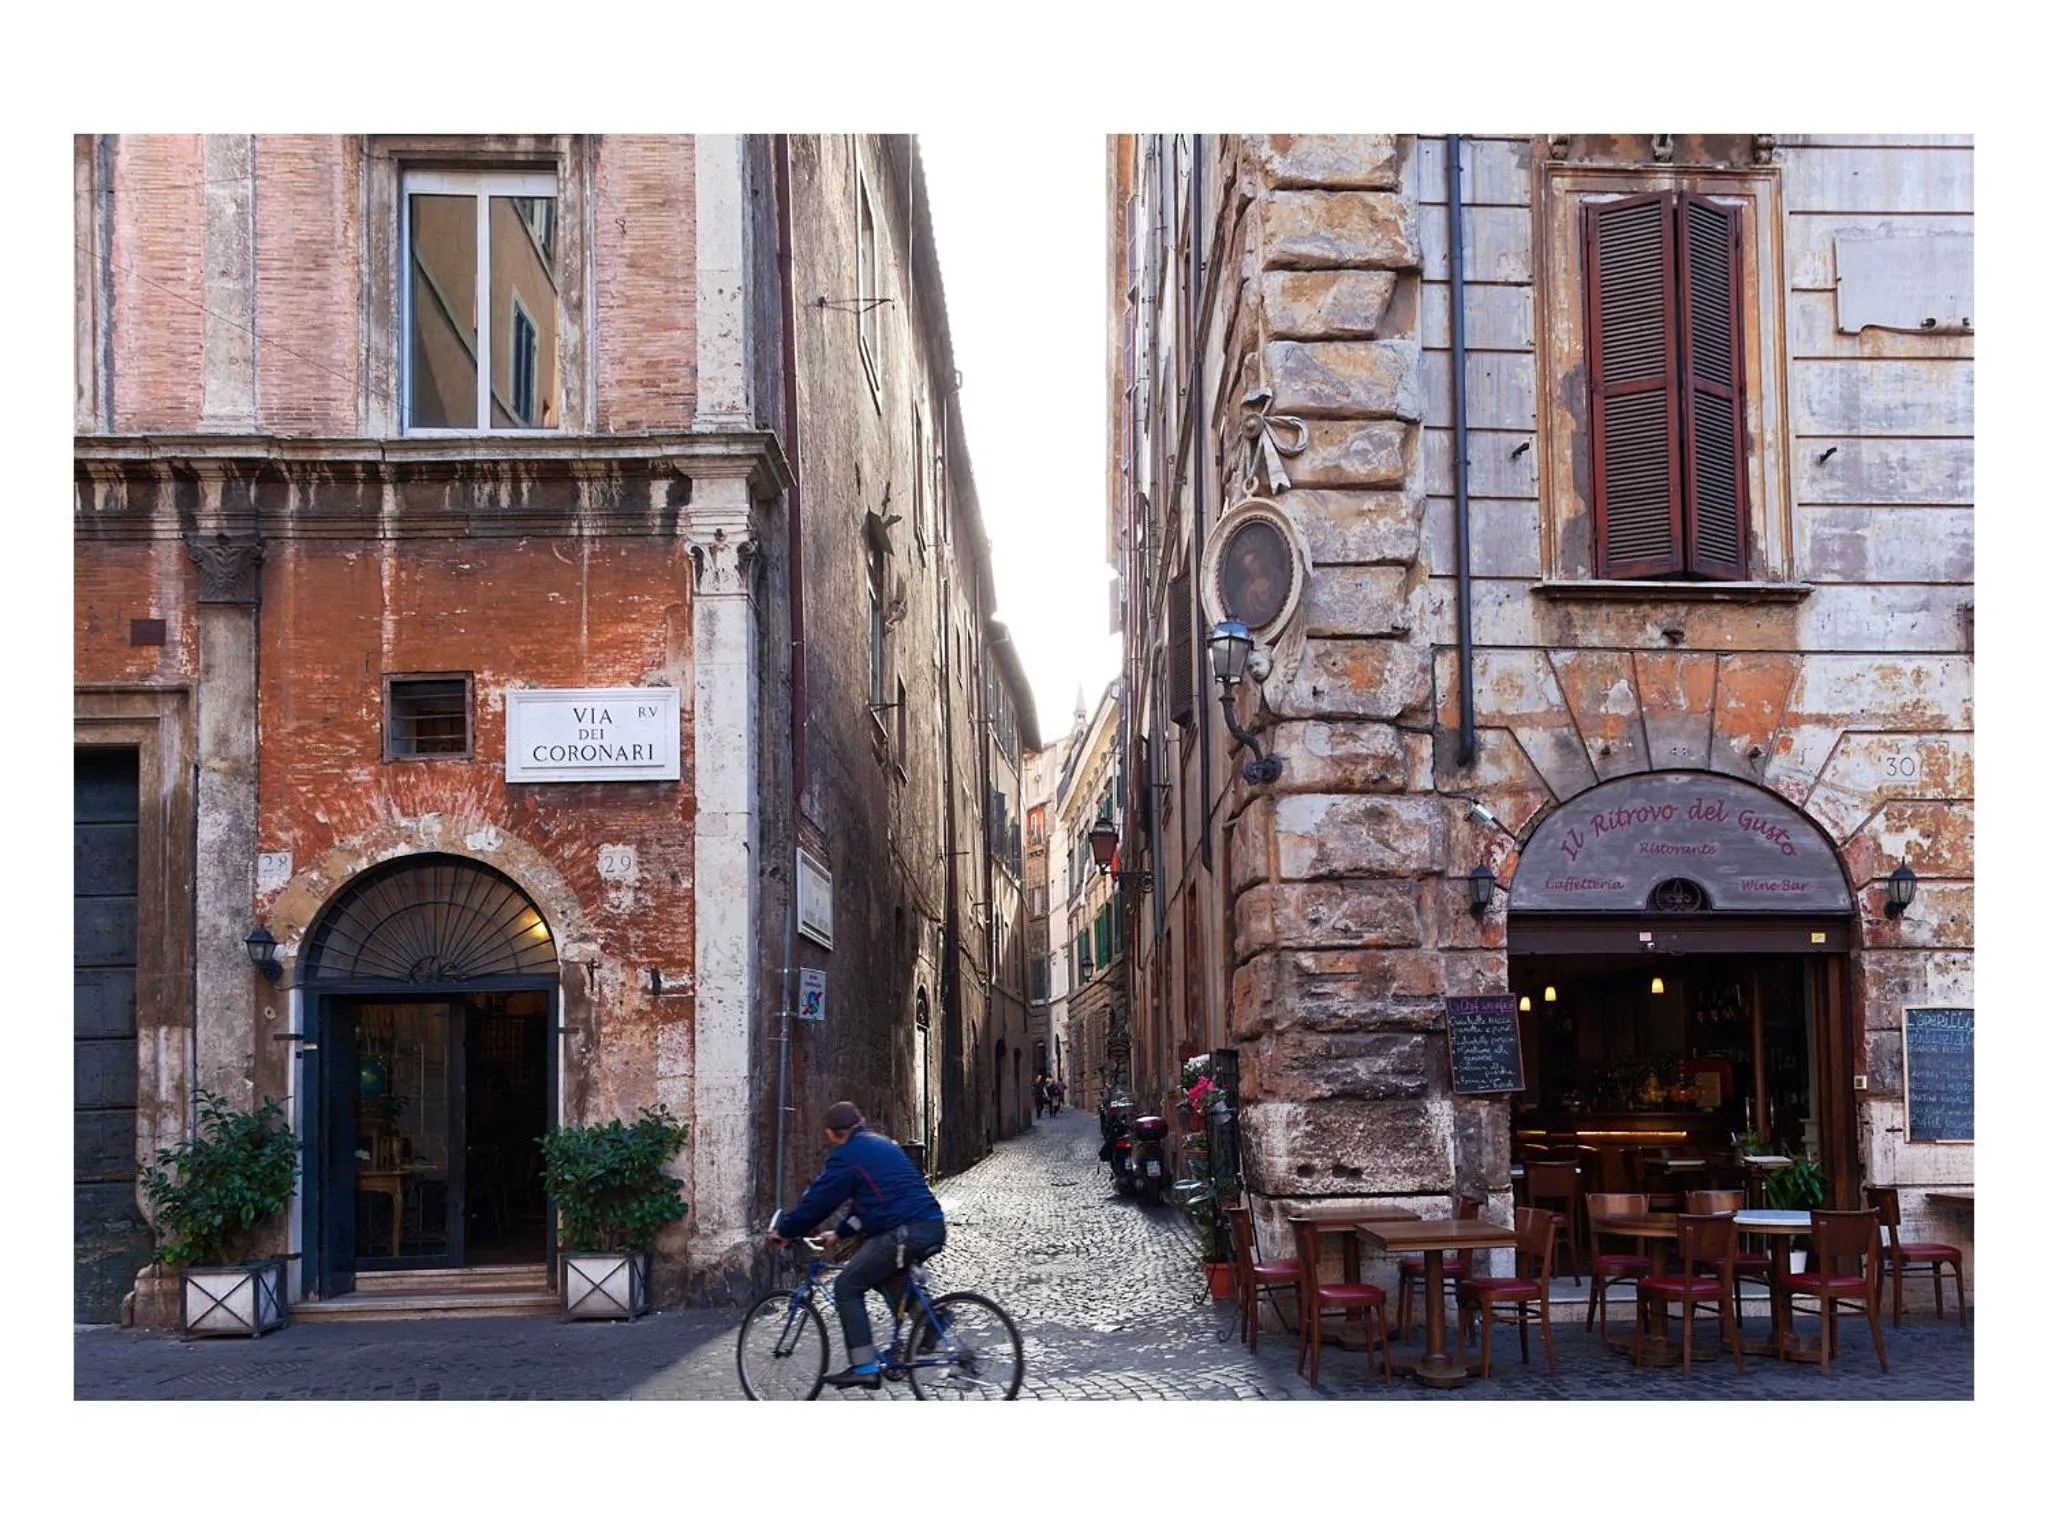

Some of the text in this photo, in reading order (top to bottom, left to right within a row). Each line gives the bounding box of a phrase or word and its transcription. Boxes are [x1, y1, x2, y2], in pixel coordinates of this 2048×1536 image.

[573, 708, 613, 724] VIA
[638, 706, 658, 718] RV
[578, 728, 604, 740] DEI
[533, 744, 653, 762] CORONARI
[1886, 756, 1915, 776] 30
[1561, 798, 1798, 861] Il Ritrovo del Gusto
[1640, 842, 1718, 856] Ristorante
[604, 855, 632, 873] 29
[1741, 879, 1810, 892] Wine Bar
